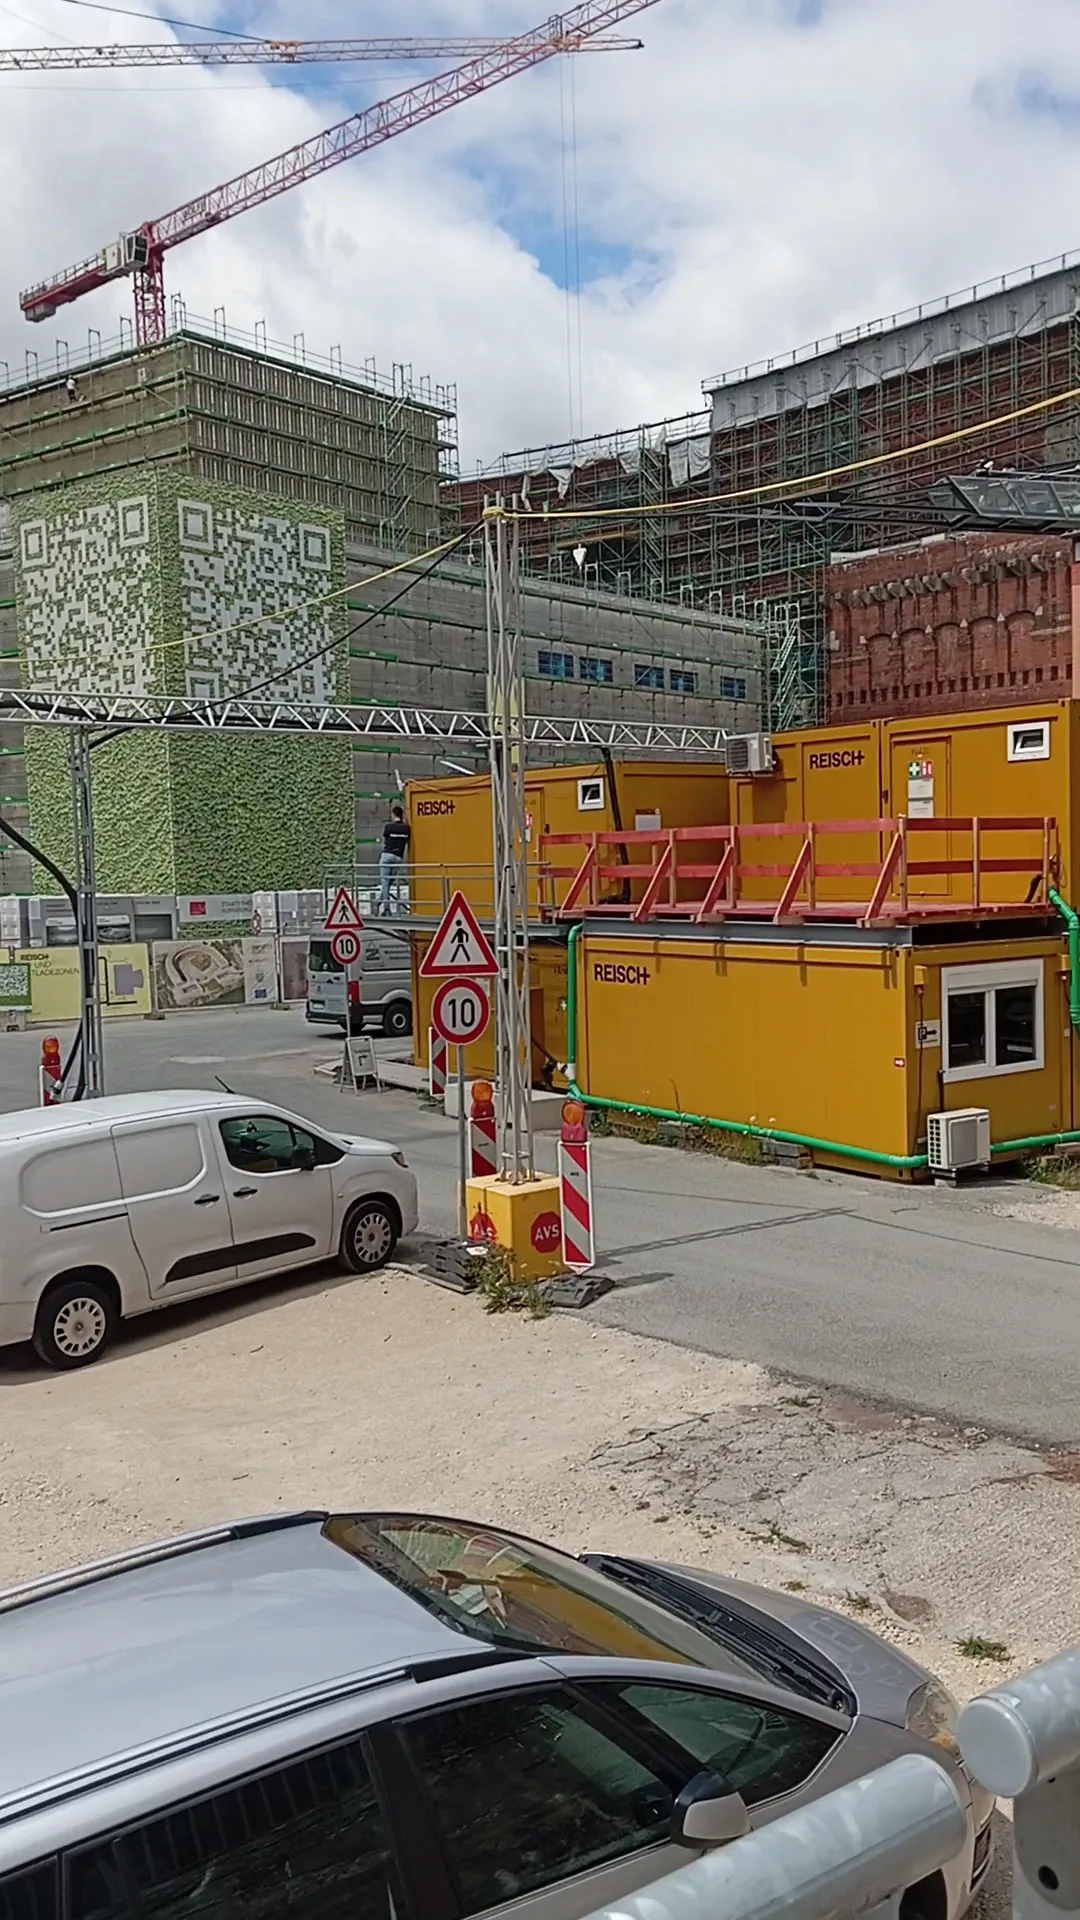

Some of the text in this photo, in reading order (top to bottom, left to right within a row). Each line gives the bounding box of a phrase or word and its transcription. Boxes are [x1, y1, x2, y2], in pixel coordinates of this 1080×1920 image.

[339, 938, 354, 955] 10
[448, 998, 475, 1028] 10
[535, 1223, 560, 1242] AVS
